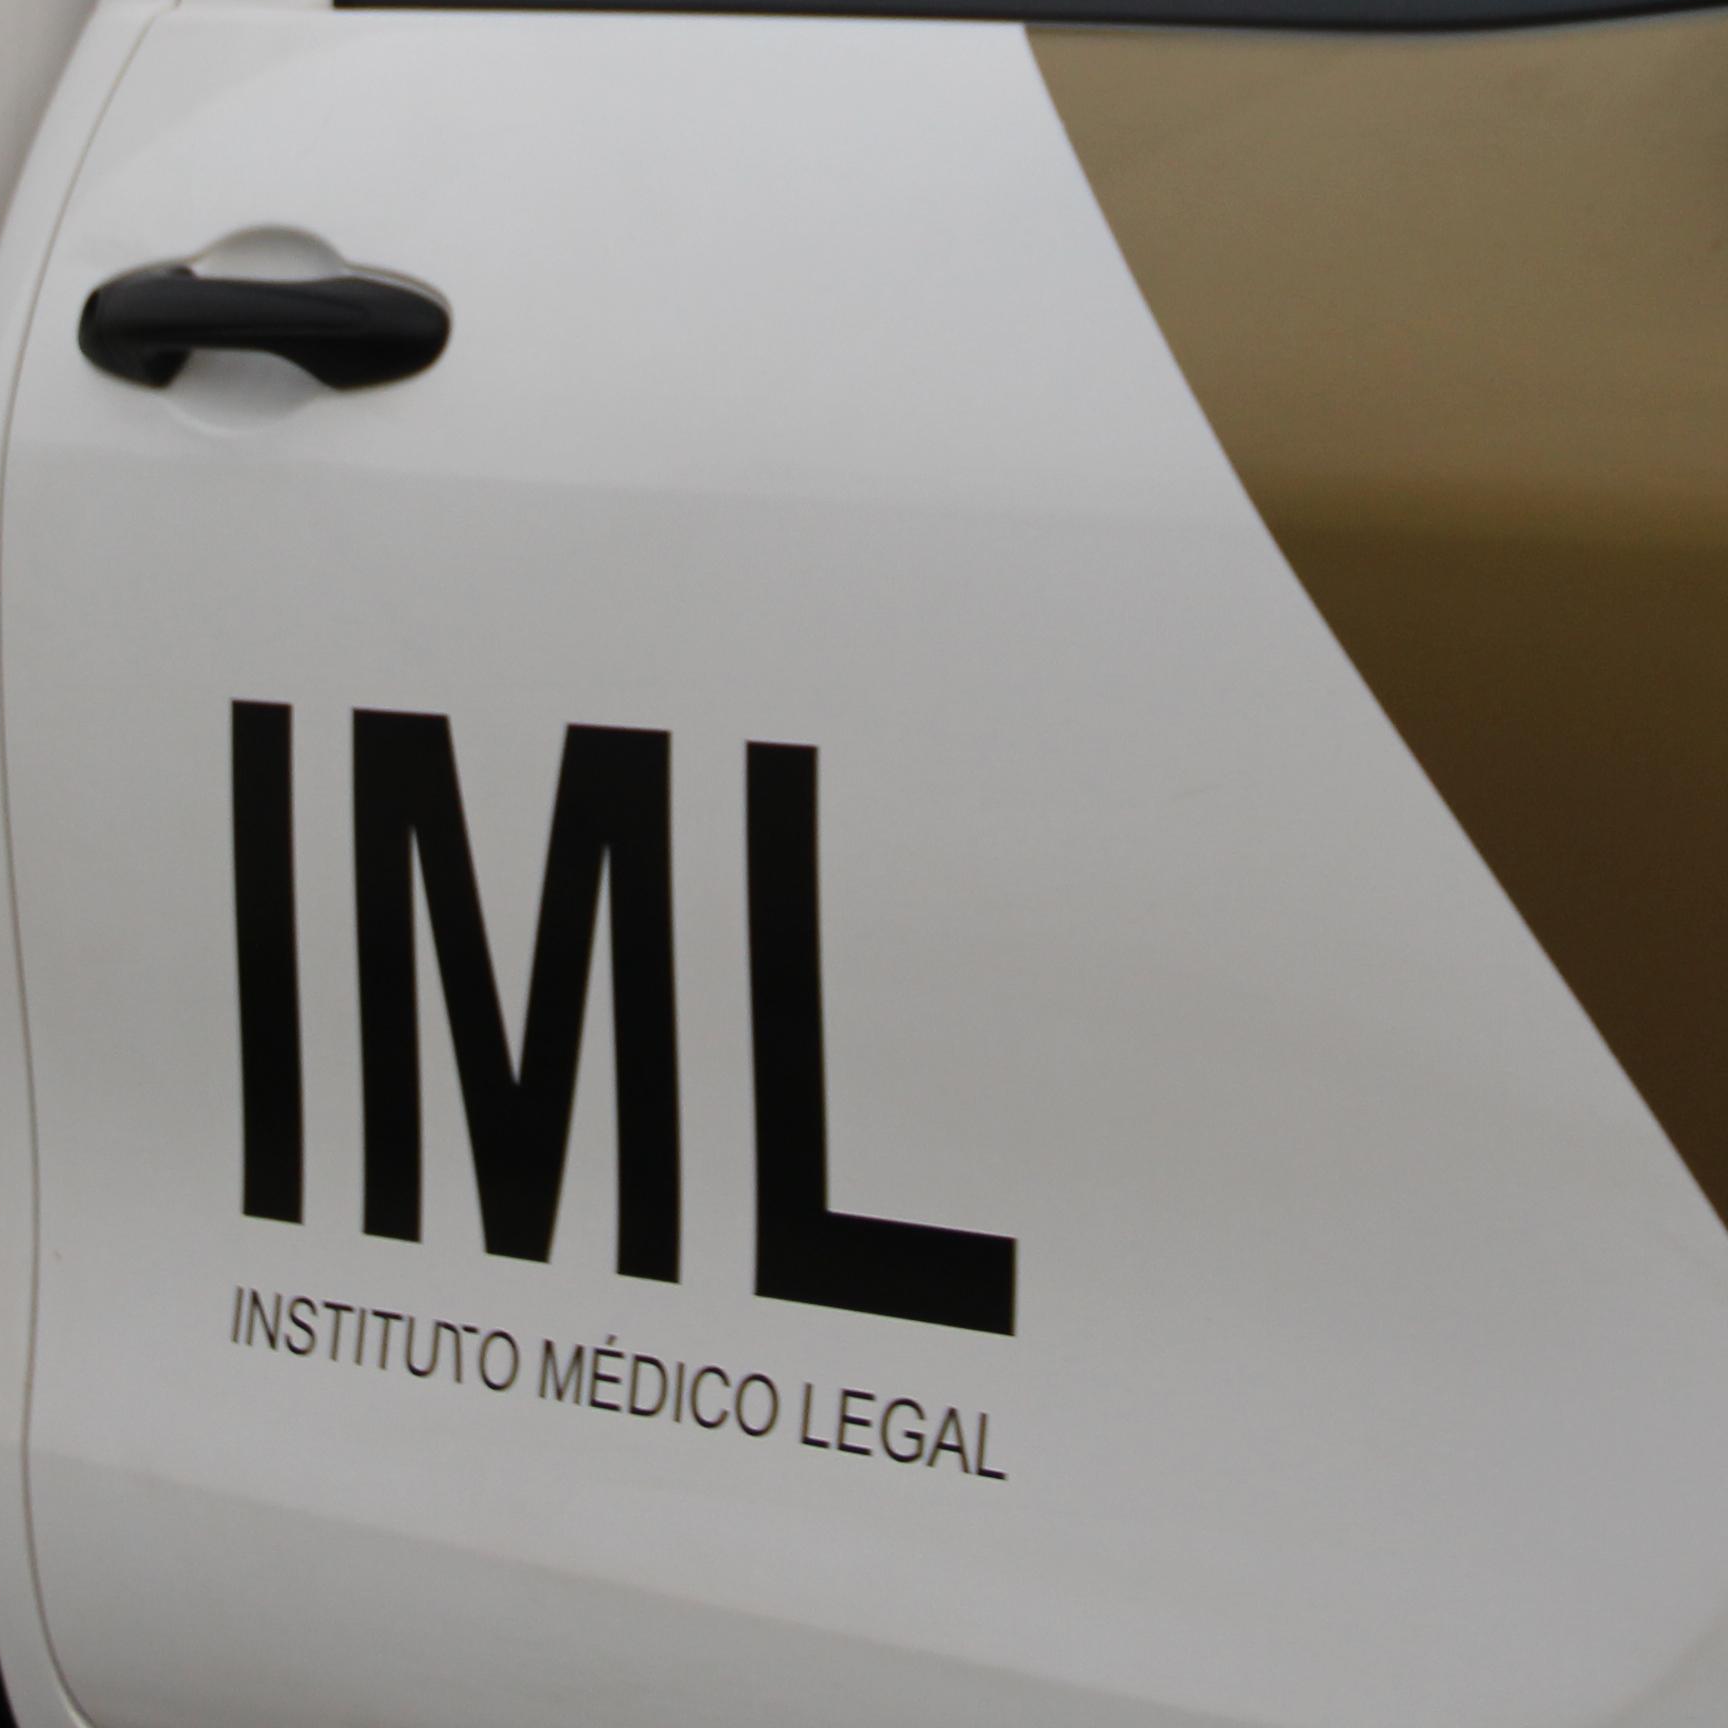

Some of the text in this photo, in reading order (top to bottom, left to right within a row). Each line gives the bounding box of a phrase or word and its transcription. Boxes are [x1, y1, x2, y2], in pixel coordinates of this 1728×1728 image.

[229, 698, 1017, 1337] IML
[230, 1284, 1009, 1482] INSTITUTO MÉDICO LEGAL
